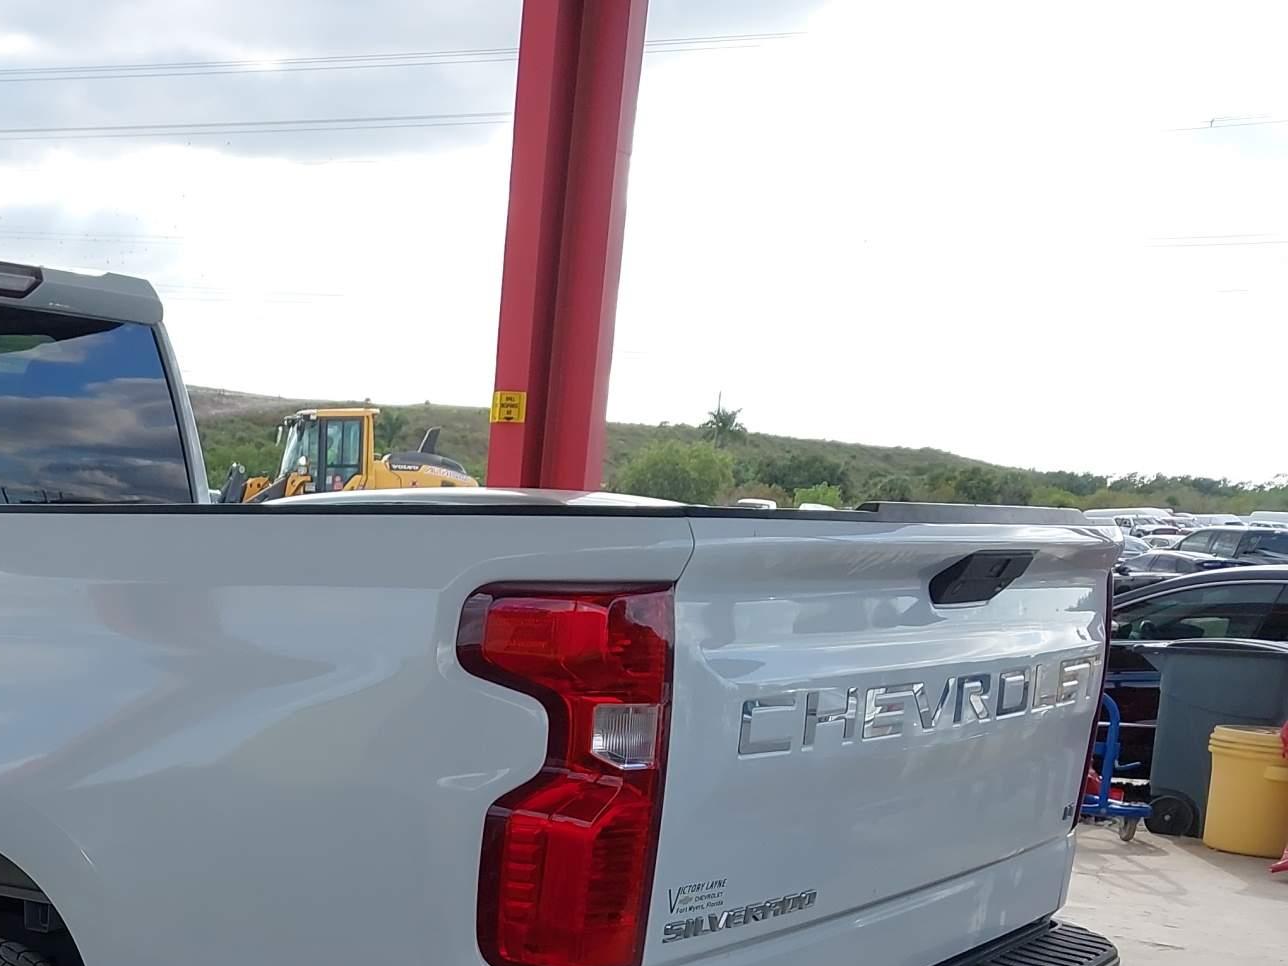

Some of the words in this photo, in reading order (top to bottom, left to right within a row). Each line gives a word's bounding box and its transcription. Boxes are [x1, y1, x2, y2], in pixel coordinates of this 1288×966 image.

[392, 463, 419, 471] VOLVO
[737, 655, 1099, 759] CHEVROLET
[662, 888, 817, 944] SILVERADO
[668, 881, 706, 914] VICTORY
[705, 878, 728, 891] LAYNE
